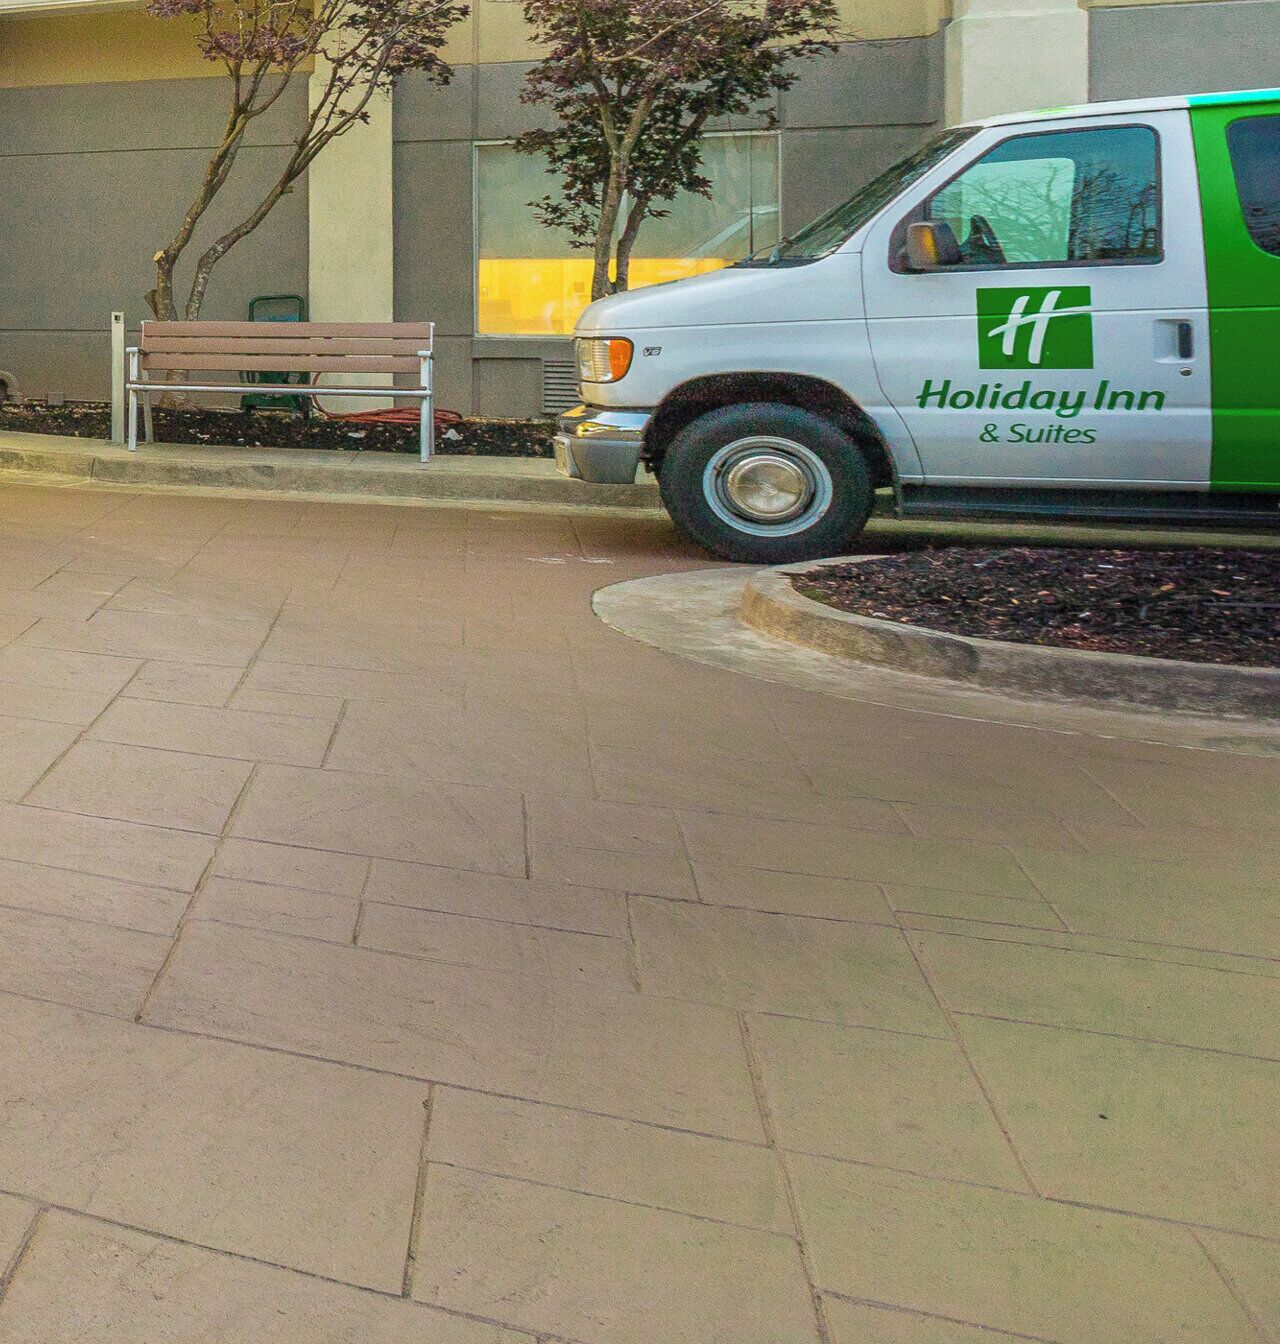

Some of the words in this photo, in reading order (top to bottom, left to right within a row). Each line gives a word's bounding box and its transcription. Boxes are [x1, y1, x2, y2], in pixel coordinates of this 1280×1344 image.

[916, 379, 1086, 418] Holiday
[1094, 379, 1165, 411] Inn
[979, 423, 999, 443] &
[1007, 423, 1097, 444] Suites
